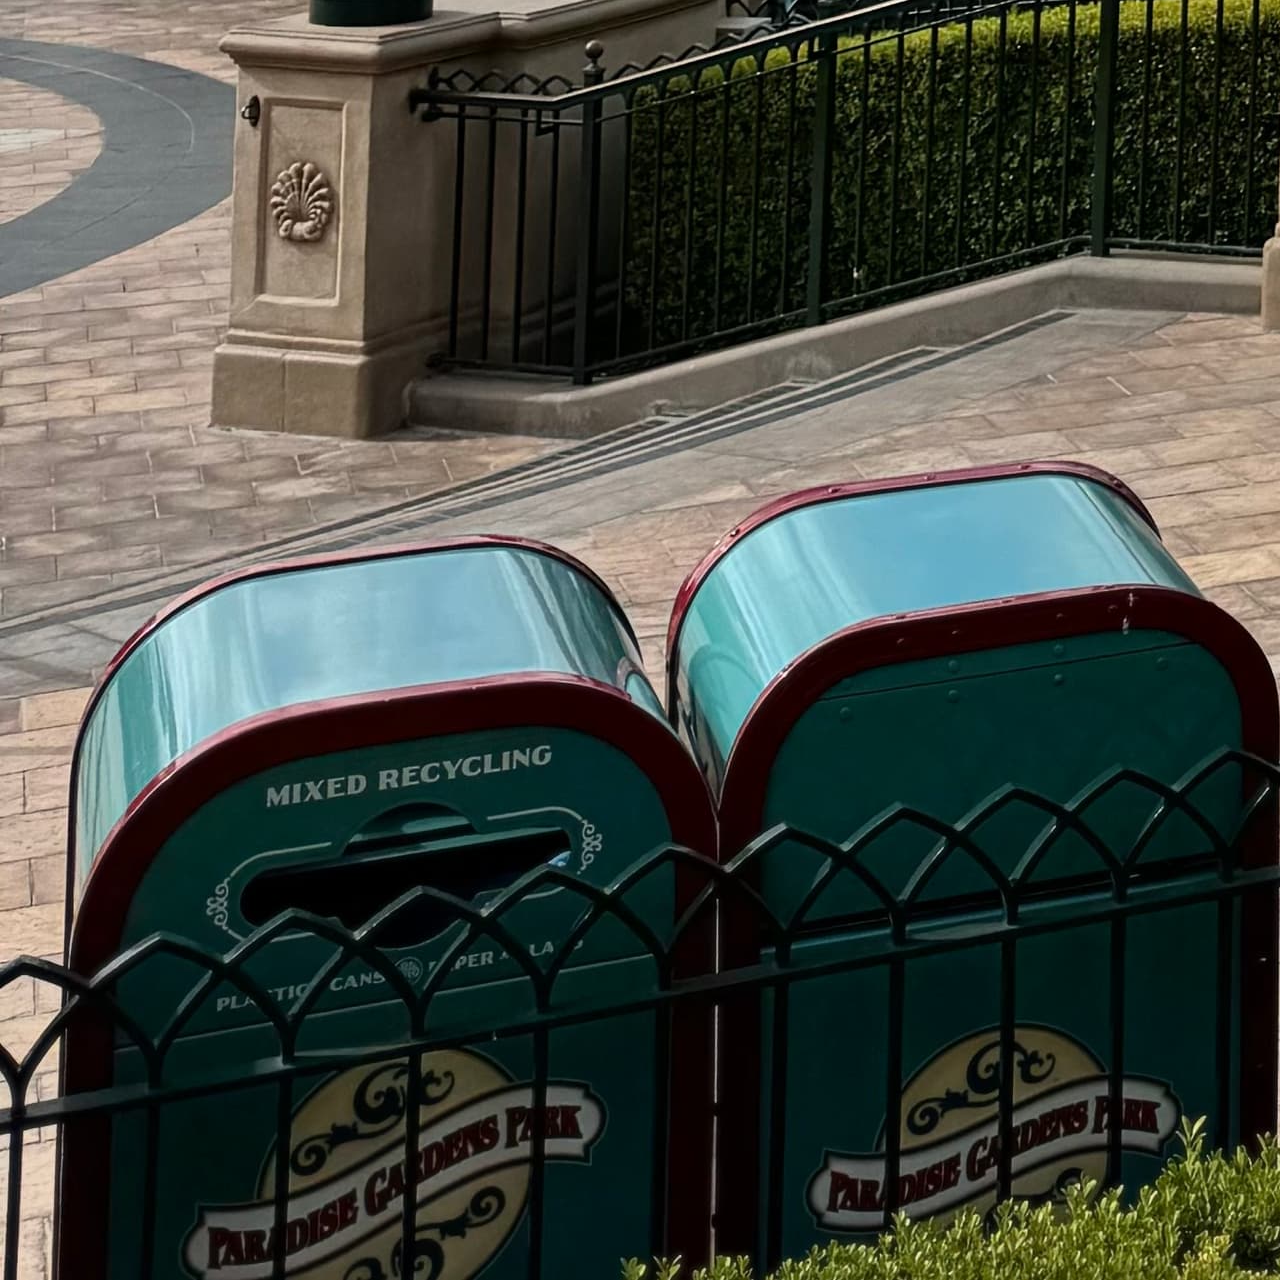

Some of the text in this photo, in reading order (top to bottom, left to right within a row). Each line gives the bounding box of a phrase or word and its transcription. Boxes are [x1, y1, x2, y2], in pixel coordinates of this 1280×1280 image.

[266, 745, 553, 808] MIXED RECYCLING
[216, 971, 387, 1012] PLATIC CANS
[827, 1153, 961, 1213] PARDISE
